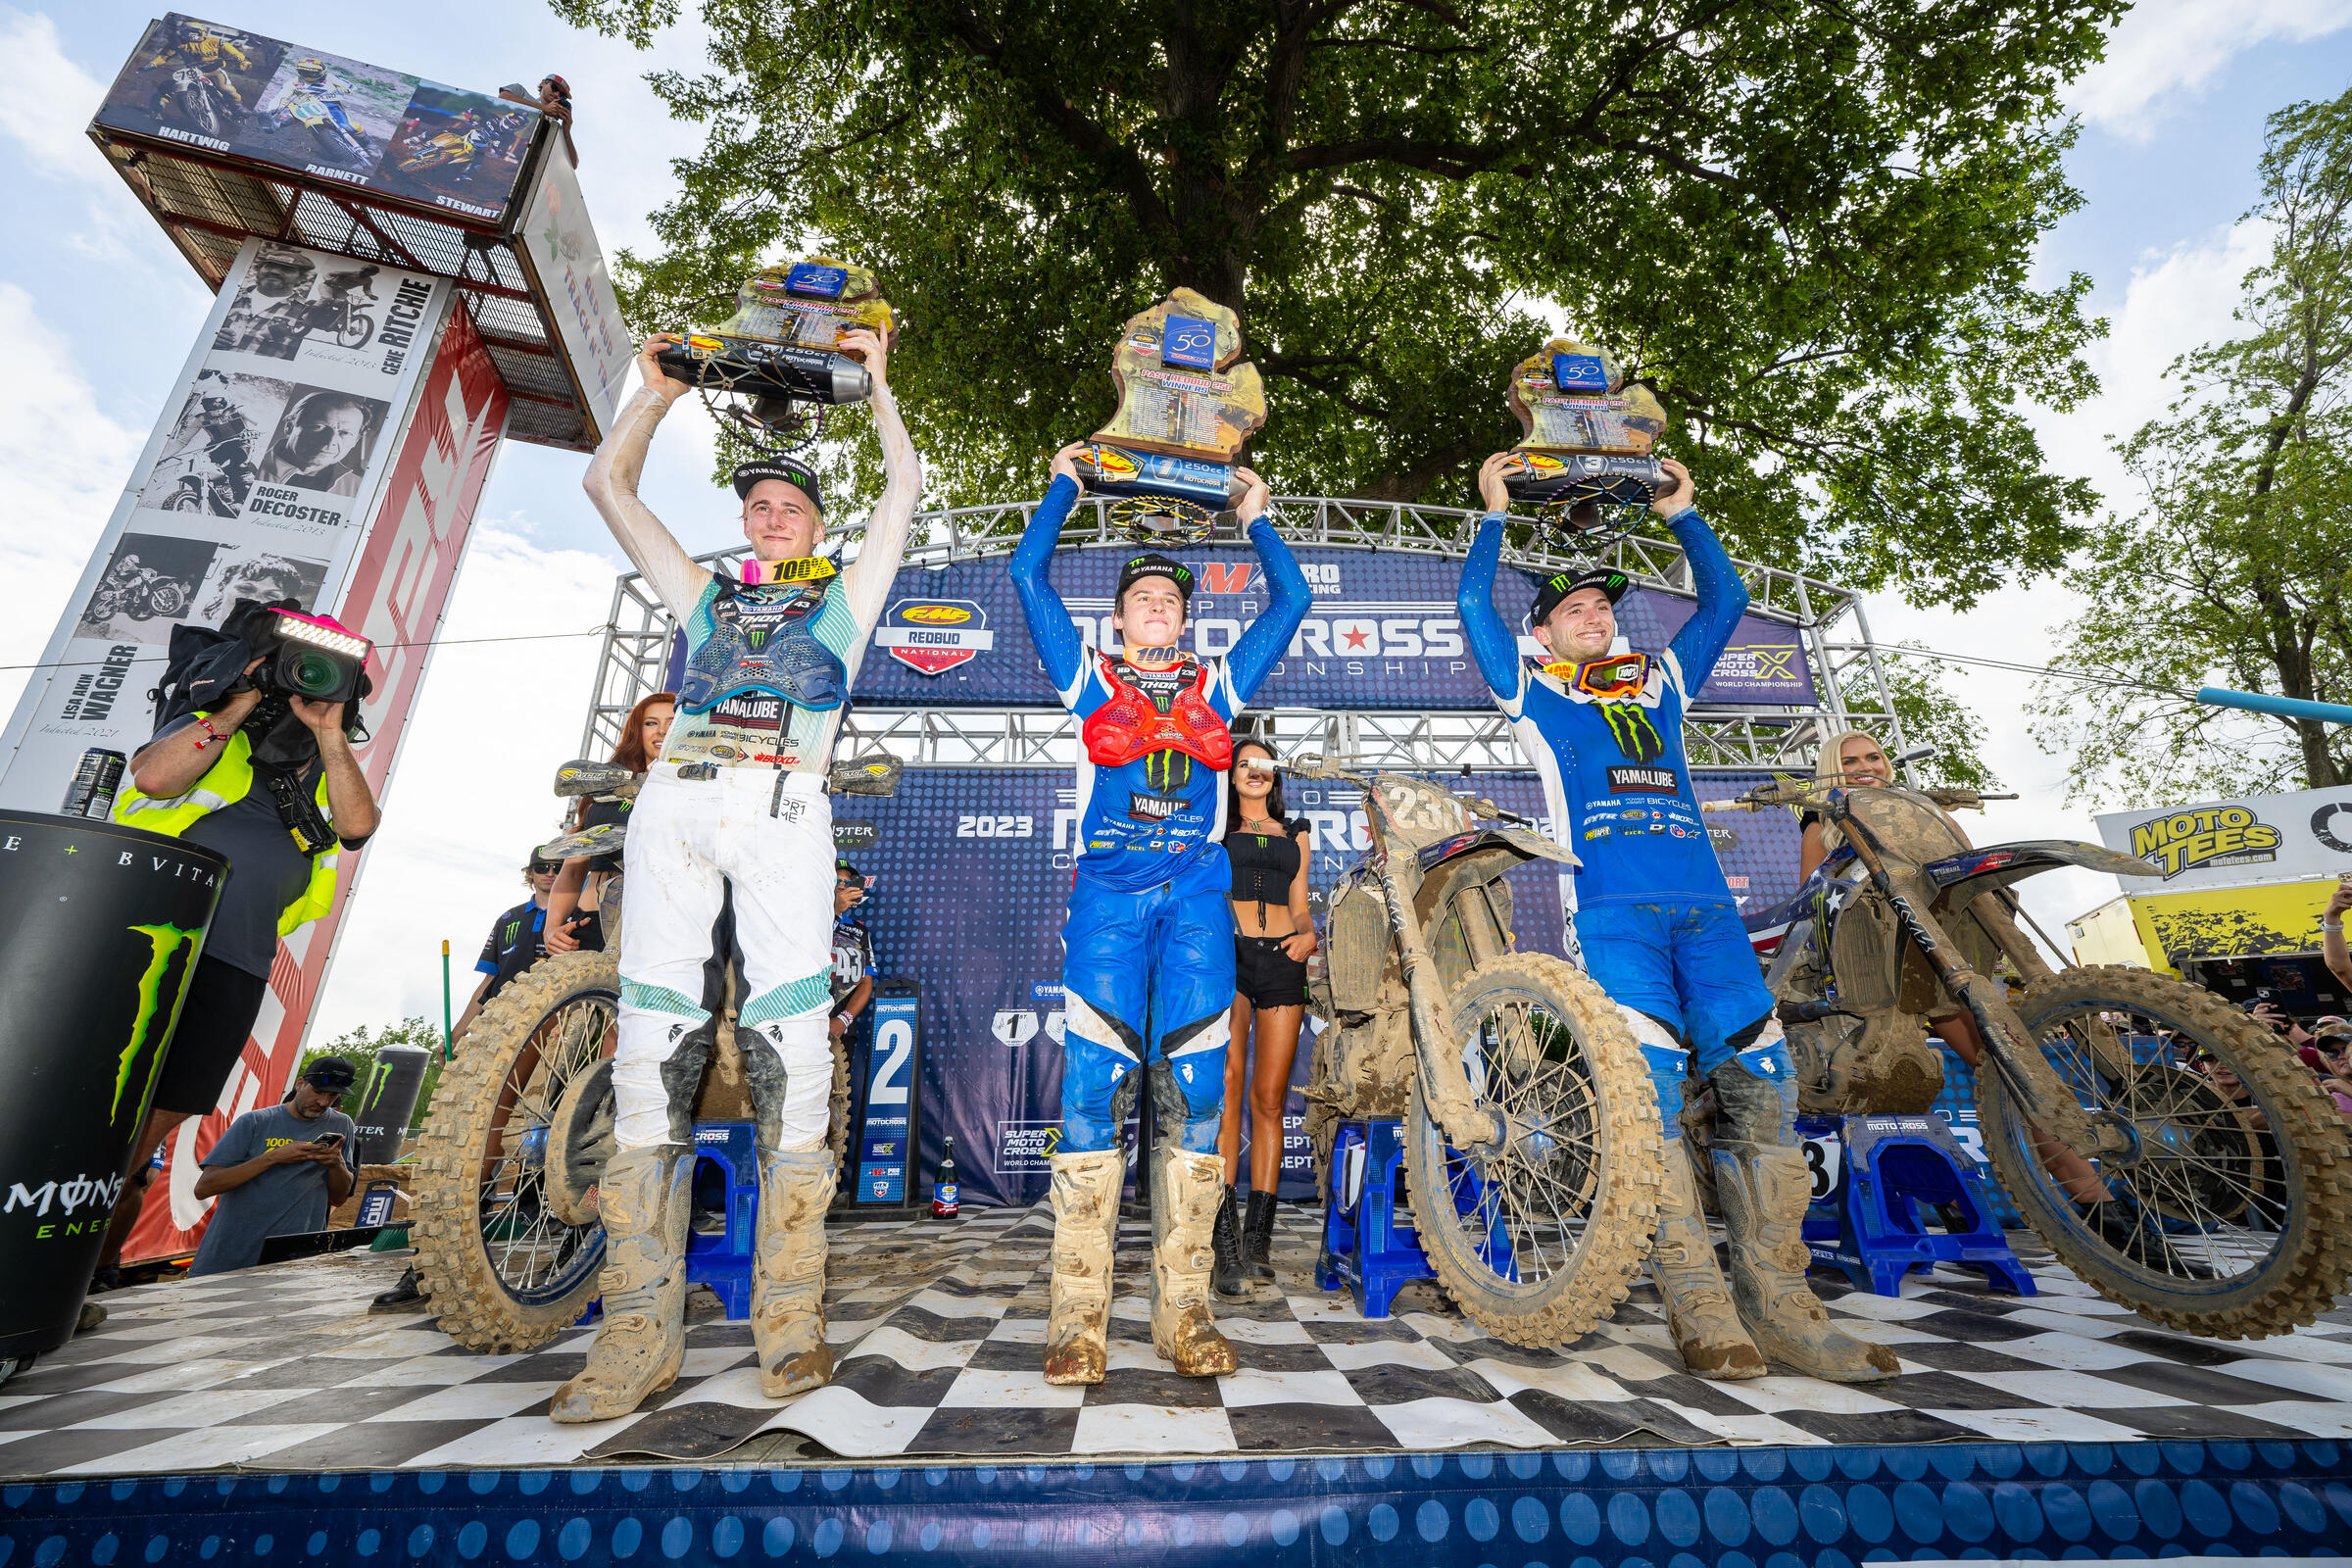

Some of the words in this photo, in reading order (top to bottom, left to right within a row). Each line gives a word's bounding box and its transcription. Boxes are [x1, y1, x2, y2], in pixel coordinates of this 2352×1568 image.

[158, 125, 230, 152] HARTWIG
[305, 163, 369, 186] BARNETT
[435, 195, 501, 220] STEWART
[796, 273, 840, 285] 50
[564, 264, 591, 340] TRACK
[377, 277, 433, 350] RITCHIE
[584, 273, 600, 317] RED
[598, 318, 613, 357] BUD
[1171, 334, 1211, 352] 50
[785, 347, 828, 358] 250cc
[381, 349, 406, 375] GENE
[1141, 368, 1170, 380] PAST
[1170, 373, 1211, 388] REDBUD
[1211, 381, 1233, 392] 250
[1566, 366, 1599, 379] 50
[1162, 379, 1208, 394] WINNERS
[788, 461, 811, 477] YAMAHA
[1185, 461, 1222, 474] 250cc
[1584, 457, 1604, 470] 3
[1609, 456, 1648, 465] 250cc
[749, 467, 788, 477] YAMAHA
[256, 486, 299, 503] ROGER
[248, 500, 342, 526] DECOSTER
[772, 557, 829, 582] 100%
[738, 614, 784, 624] THOR
[908, 631, 960, 645] REDBUD
[1136, 647, 1187, 662] 100%
[1718, 653, 1757, 662] UPER
[1619, 668, 1637, 677] 100%
[1713, 661, 1756, 669] MOTO
[78, 644, 138, 721] WAGNER
[61, 695, 82, 720] LISA
[74, 673, 95, 696] AKIN
[1612, 769, 1675, 787] YAMALUBE
[1592, 799, 1621, 808] YAMAHA
[1647, 798, 1692, 811] BICYCLES
[833, 825, 873, 837] STER
[956, 816, 1033, 838] 2023
[1108, 819, 1135, 829] YAMAHA
[2132, 808, 2254, 858] MOTO
[2157, 825, 2280, 879] TEES
[2209, 853, 2273, 867] mototees.com
[836, 947, 862, 984] 43
[869, 1019, 912, 1104] 2
[1866, 1122, 1929, 1131] MOTOCROSS
[1801, 1141, 1831, 1198] 3
